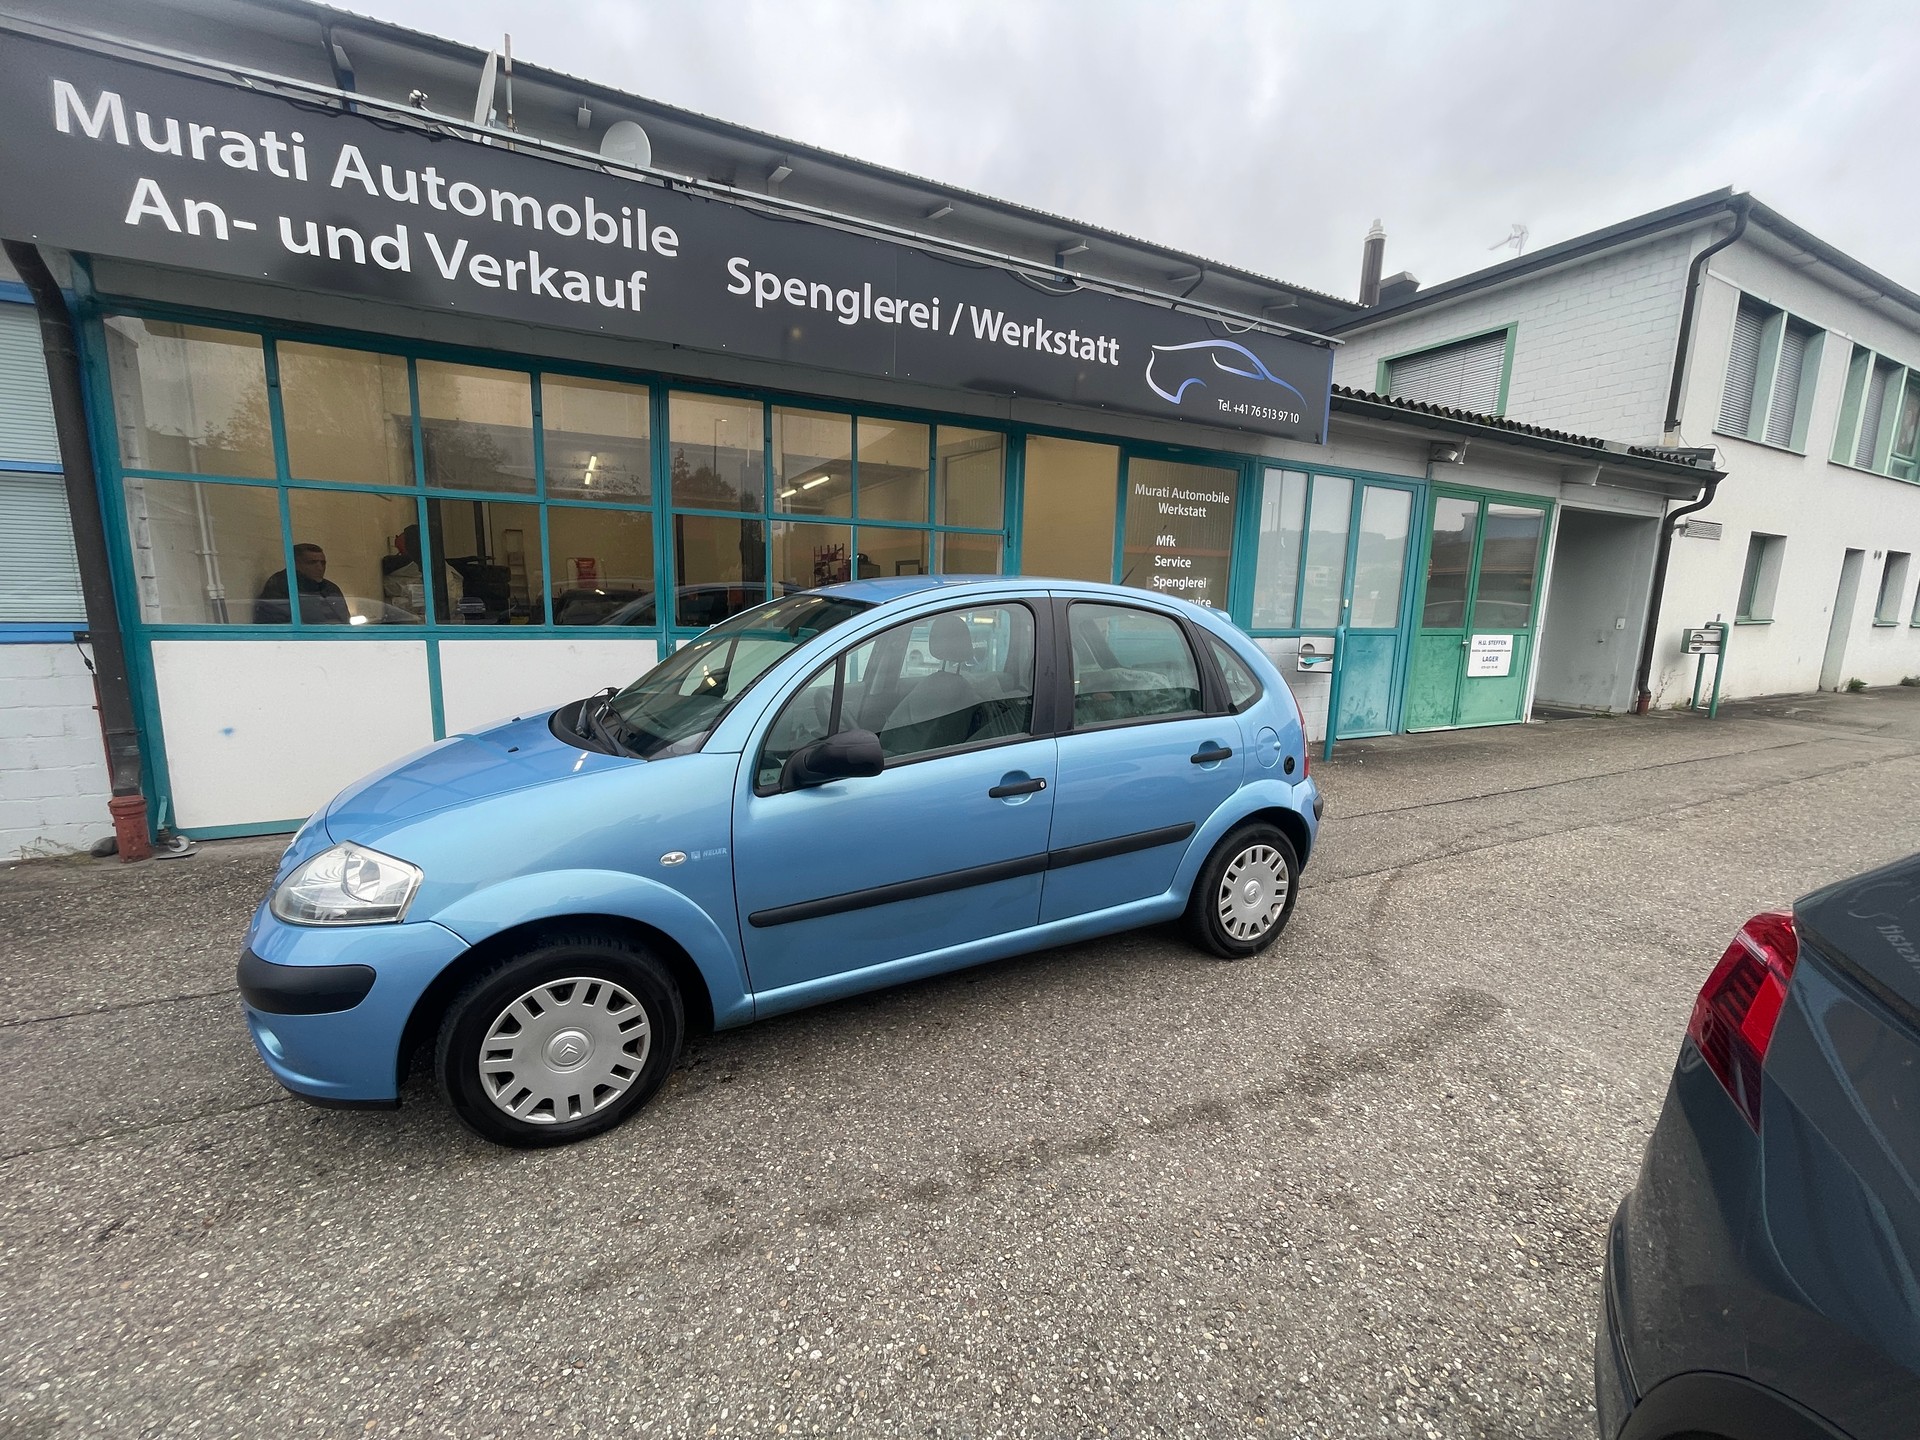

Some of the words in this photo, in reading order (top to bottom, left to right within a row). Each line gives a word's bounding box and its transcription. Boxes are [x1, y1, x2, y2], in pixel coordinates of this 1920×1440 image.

[52, 79, 308, 182] Murati
[330, 143, 679, 257] Automobile
[124, 177, 257, 240] An-
[278, 216, 411, 273] und
[423, 224, 648, 312] Verkauf
[726, 255, 940, 331] Spenglerei
[949, 302, 964, 336] /
[969, 304, 1120, 366] Werkstatt
[1217, 398, 1232, 412] Tel.
[1233, 403, 1249, 415] +41
[1250, 405, 1261, 417] 76
[1261, 407, 1277, 420] 513
[1278, 410, 1288, 422] 97
[1289, 412, 1300, 424] 10
[1134, 483, 1170, 498] Murati
[1171, 487, 1230, 504] Automobile
[1158, 502, 1207, 518] Werkstatt
[1155, 534, 1176, 547] Mfk
[1154, 555, 1192, 569] Service
[1153, 575, 1207, 590] Spenglerei
